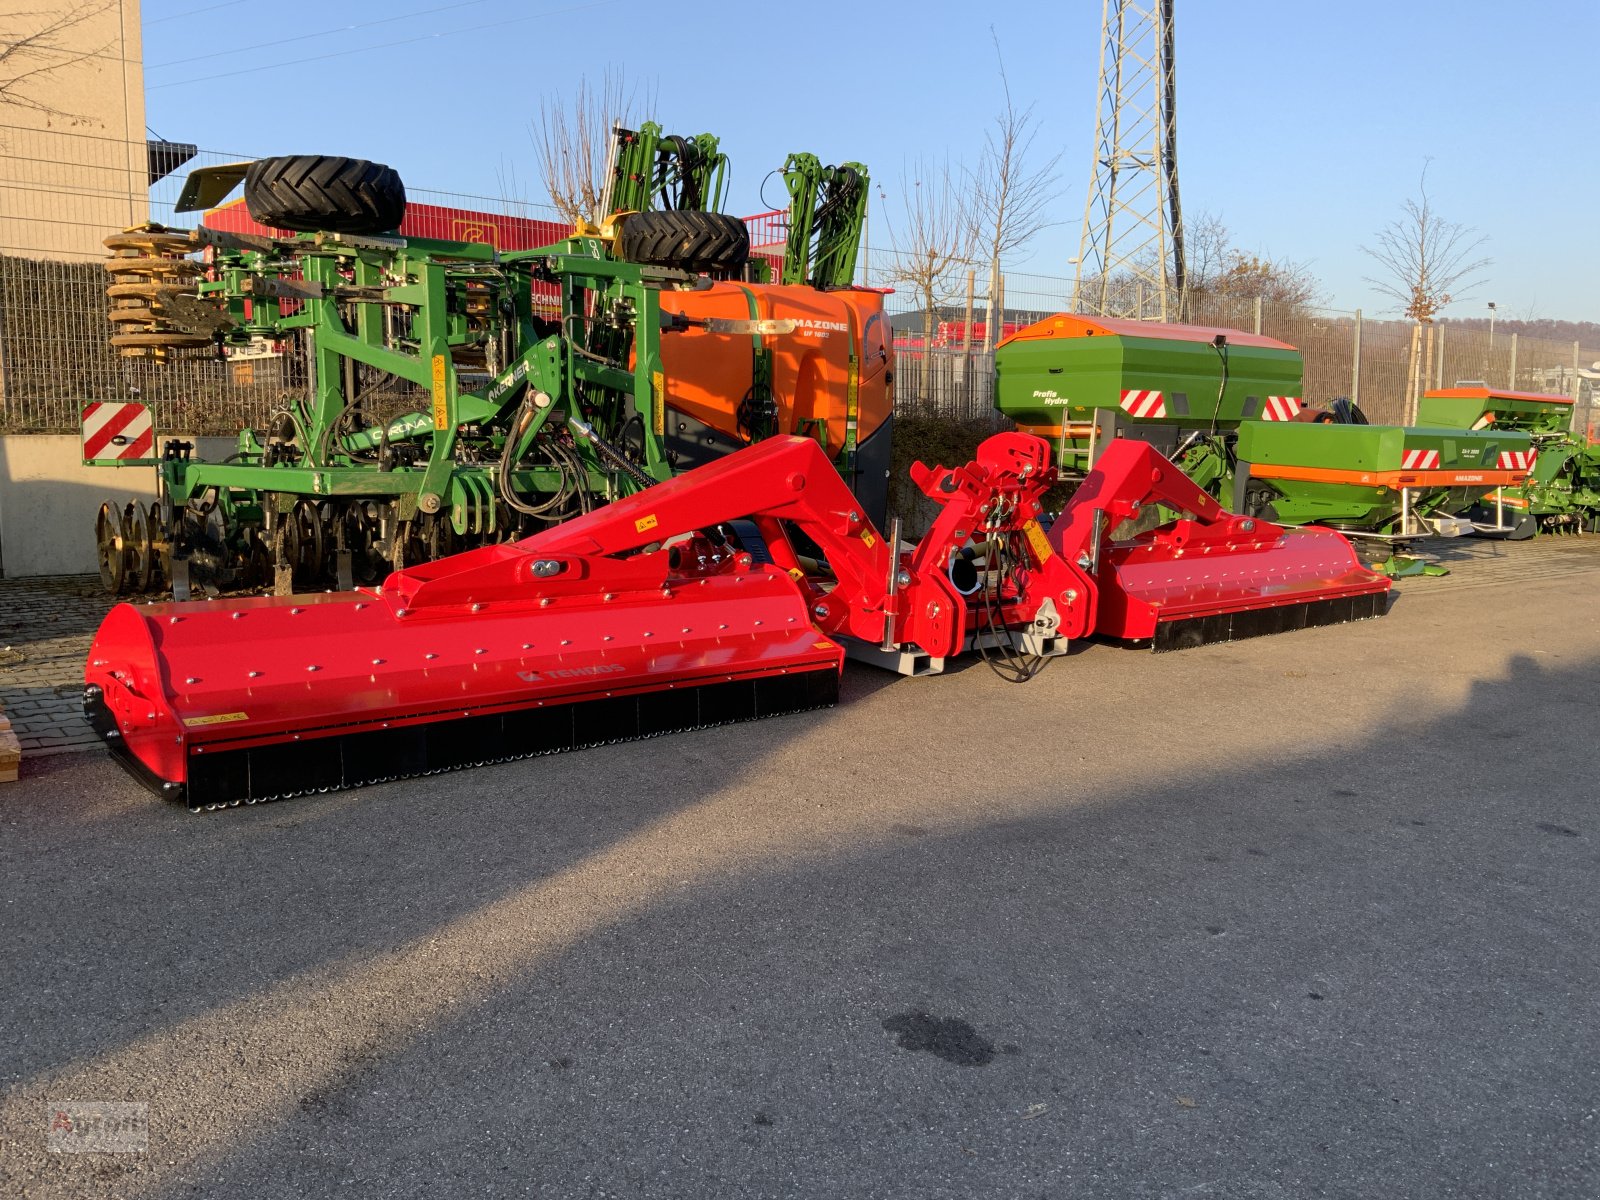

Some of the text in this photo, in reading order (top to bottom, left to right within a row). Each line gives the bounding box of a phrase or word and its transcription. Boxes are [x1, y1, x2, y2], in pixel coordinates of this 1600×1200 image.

[785, 318, 848, 332] MAZONE
[494, 360, 530, 399] KERNER
[1032, 390, 1058, 398] Profis
[1044, 397, 1069, 406] Hydro
[372, 418, 428, 440] CRONA
[544, 663, 626, 679] TEHNOS
